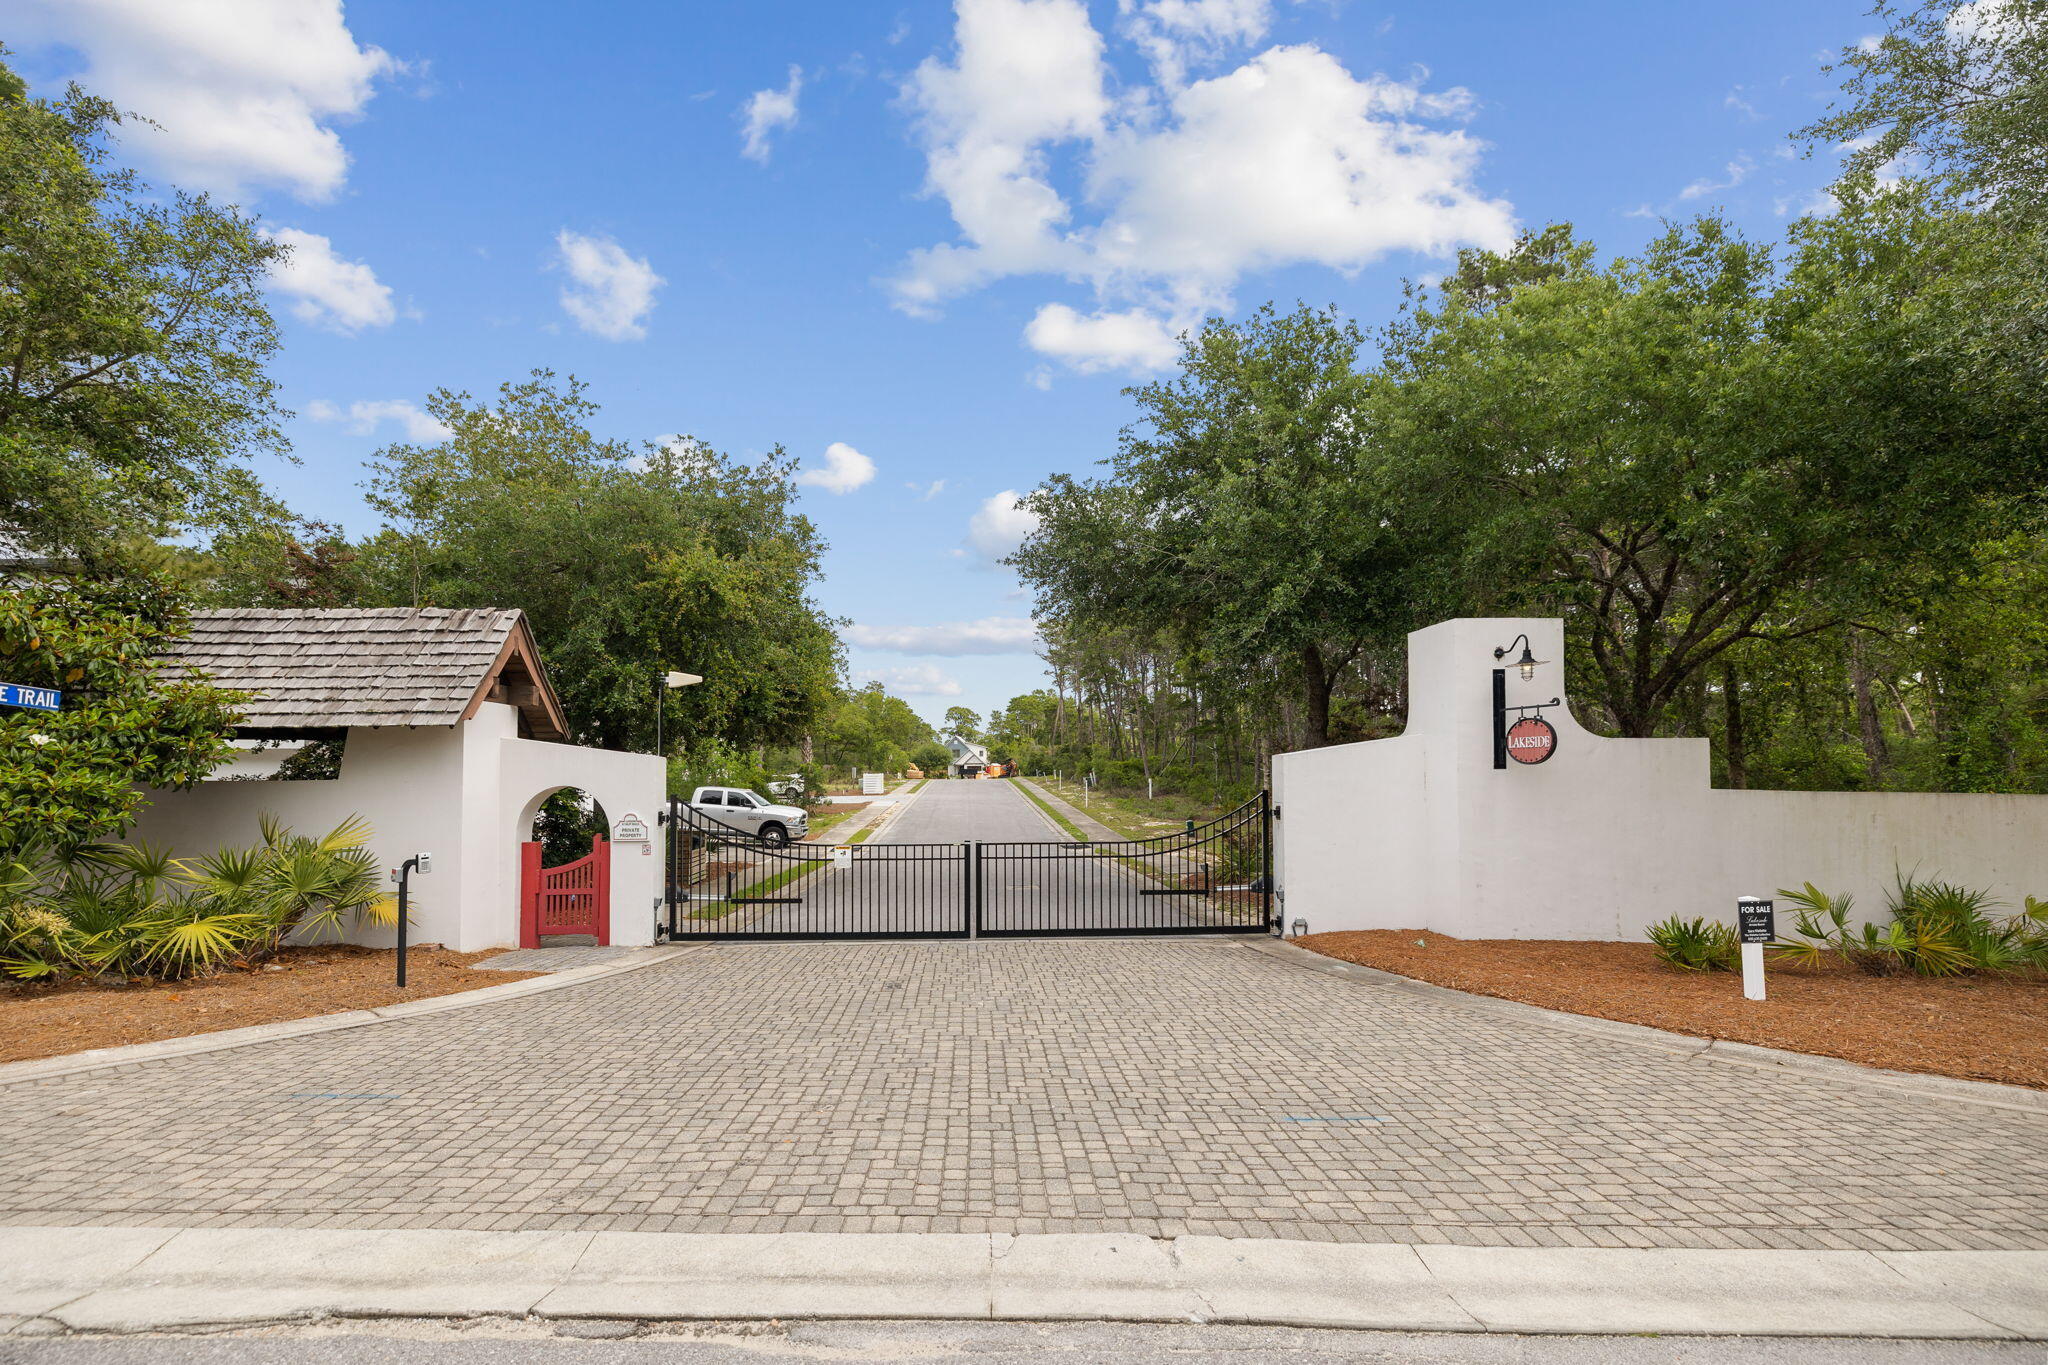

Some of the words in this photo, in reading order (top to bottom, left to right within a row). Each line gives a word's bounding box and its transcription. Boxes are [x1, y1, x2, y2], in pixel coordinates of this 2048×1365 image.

[17, 688, 59, 708] TRAIL
[1508, 735, 1550, 749] LAKESIDE
[1741, 906, 1755, 914] FOR
[1755, 905, 1771, 913] SALE
